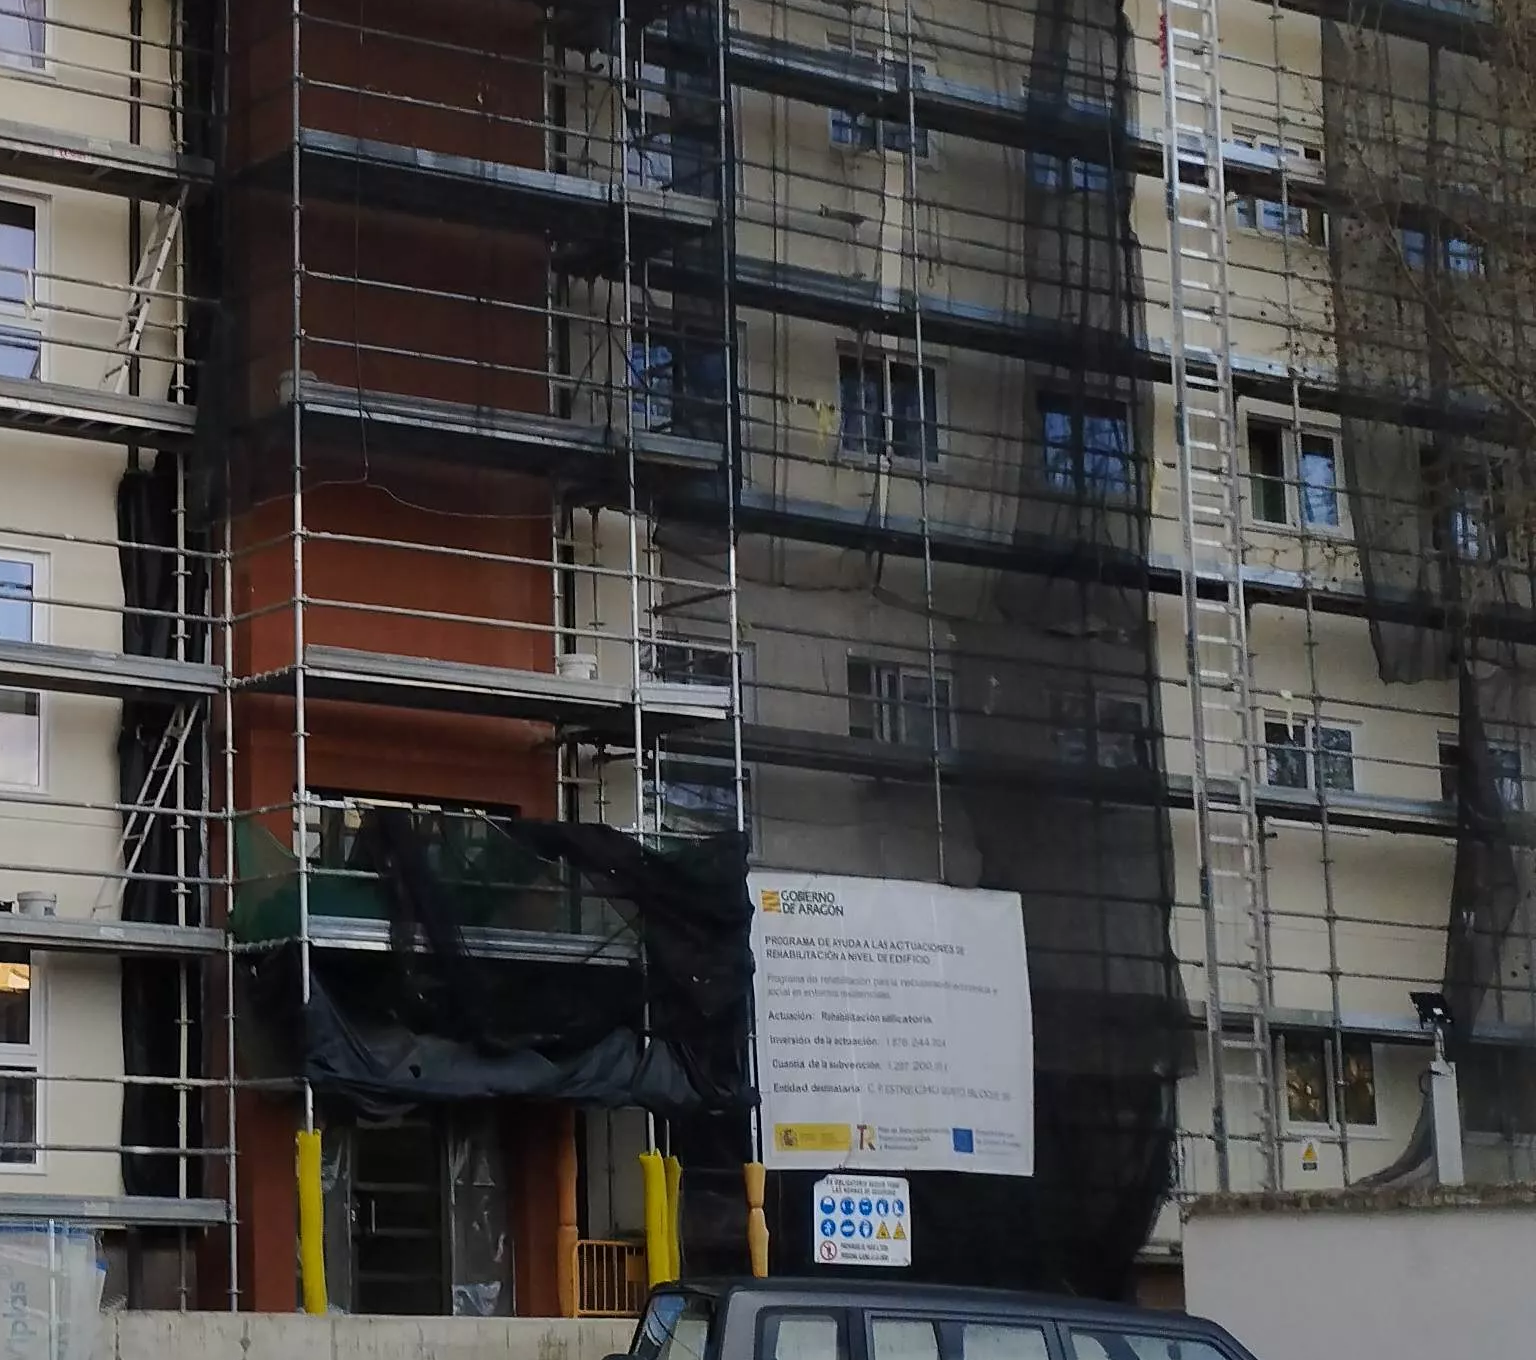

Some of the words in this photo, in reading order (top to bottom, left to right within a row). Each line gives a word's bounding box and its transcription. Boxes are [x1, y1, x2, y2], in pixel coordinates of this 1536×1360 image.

[781, 890, 835, 903] GOBIERNO
[782, 902, 795, 914] DE
[765, 935, 815, 947] PROGRAMA
[818, 937, 830, 947] DE
[833, 937, 861, 949] AYUDA
[871, 939, 888, 950] LAS
[848, 952, 874, 962] NIVEL
